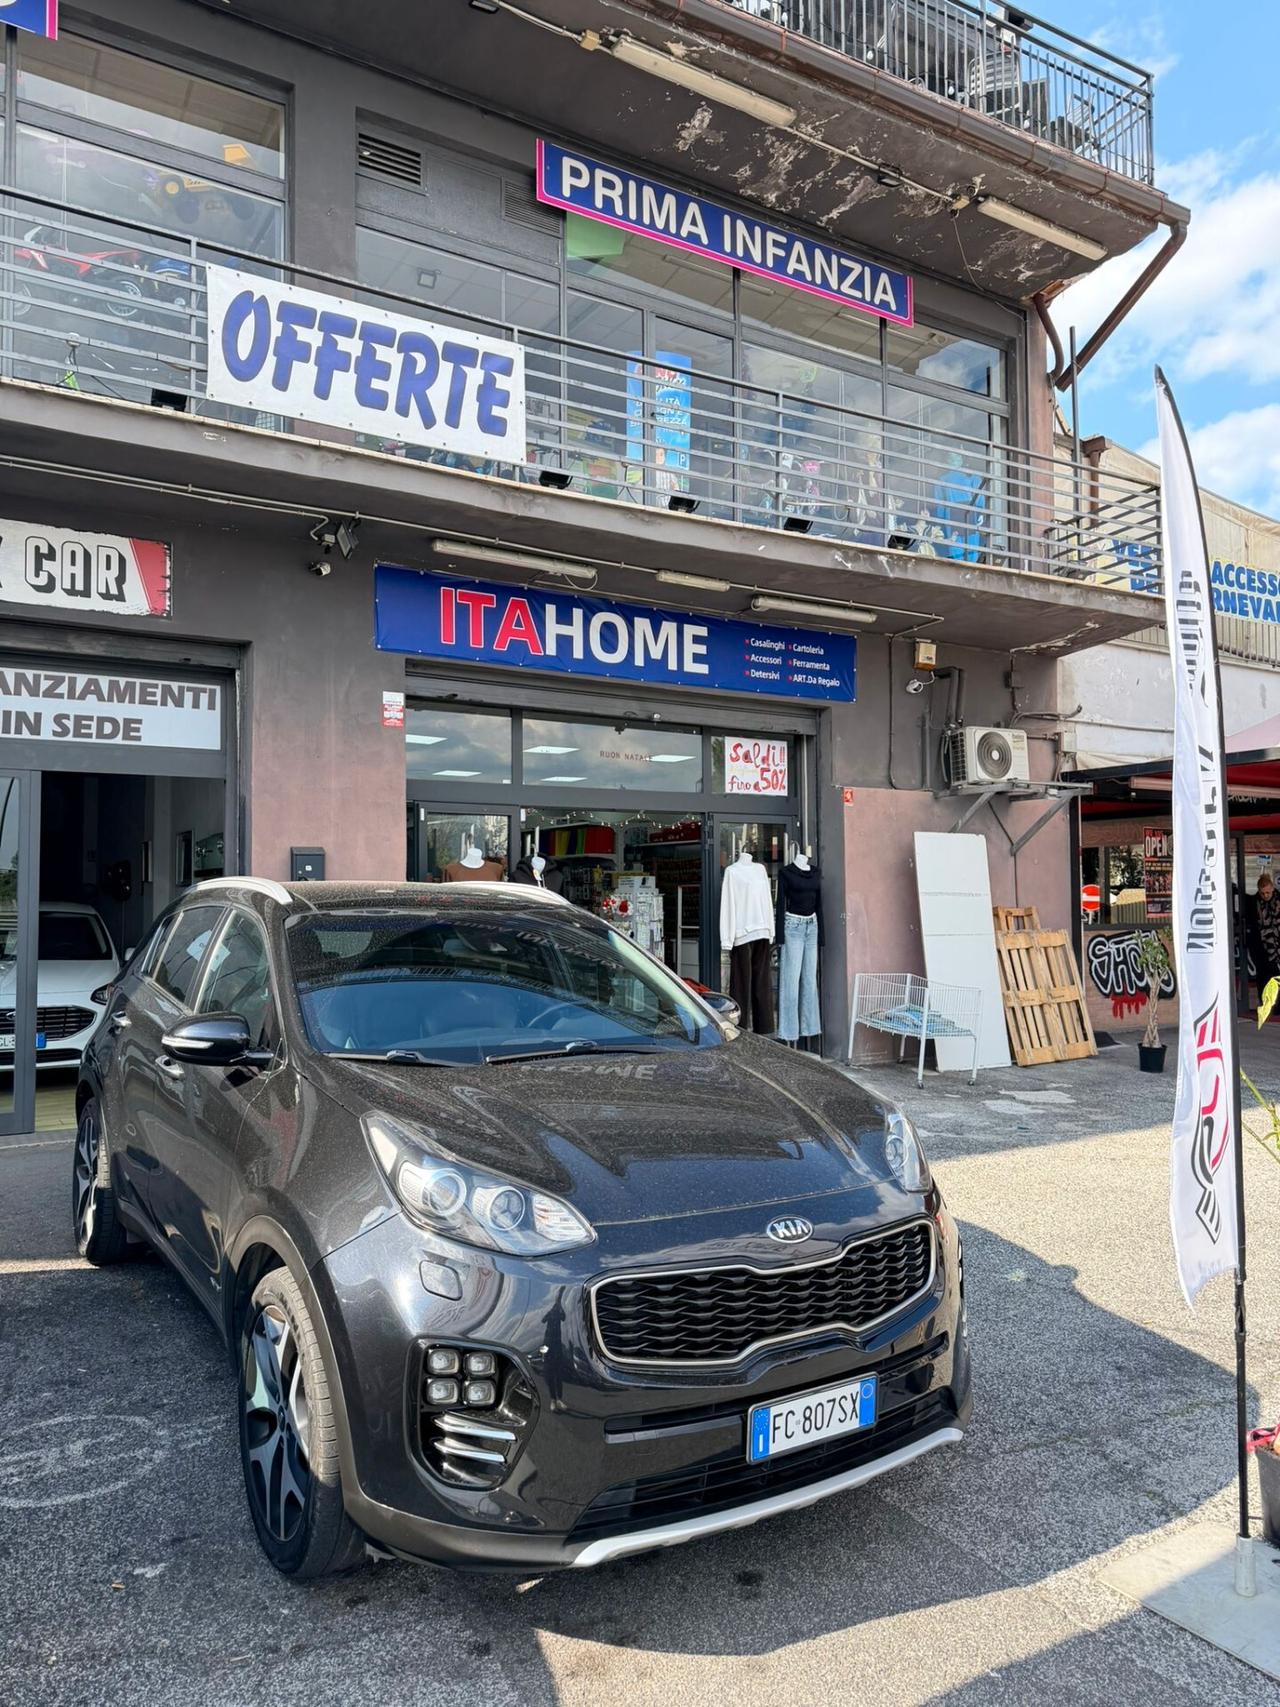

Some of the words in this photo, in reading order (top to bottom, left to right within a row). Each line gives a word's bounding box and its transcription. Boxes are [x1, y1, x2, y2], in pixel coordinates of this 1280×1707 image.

[562, 156, 708, 246] PRIMA
[723, 214, 897, 311] INFANZIA
[221, 289, 515, 438] OFFERTE
[25, 535, 127, 602] CAR
[1211, 560, 1280, 597] ACCESS
[439, 586, 710, 675] ITAHOME
[750, 638, 785, 651] Casalinghi
[793, 644, 824, 655] Cartoleria
[750, 654, 782, 665] Accessori
[793, 659, 830, 671] Ferramenta
[750, 669, 780, 680] Detersivi
[818, 677, 840, 688] Regalo
[2, 710, 43, 737] IN
[51, 712, 143, 743] SEDE
[728, 774, 752, 792] fino
[759, 767, 787, 791] 50%
[1145, 834, 1168, 858] OPEN
[773, 1219, 809, 1238] KIA
